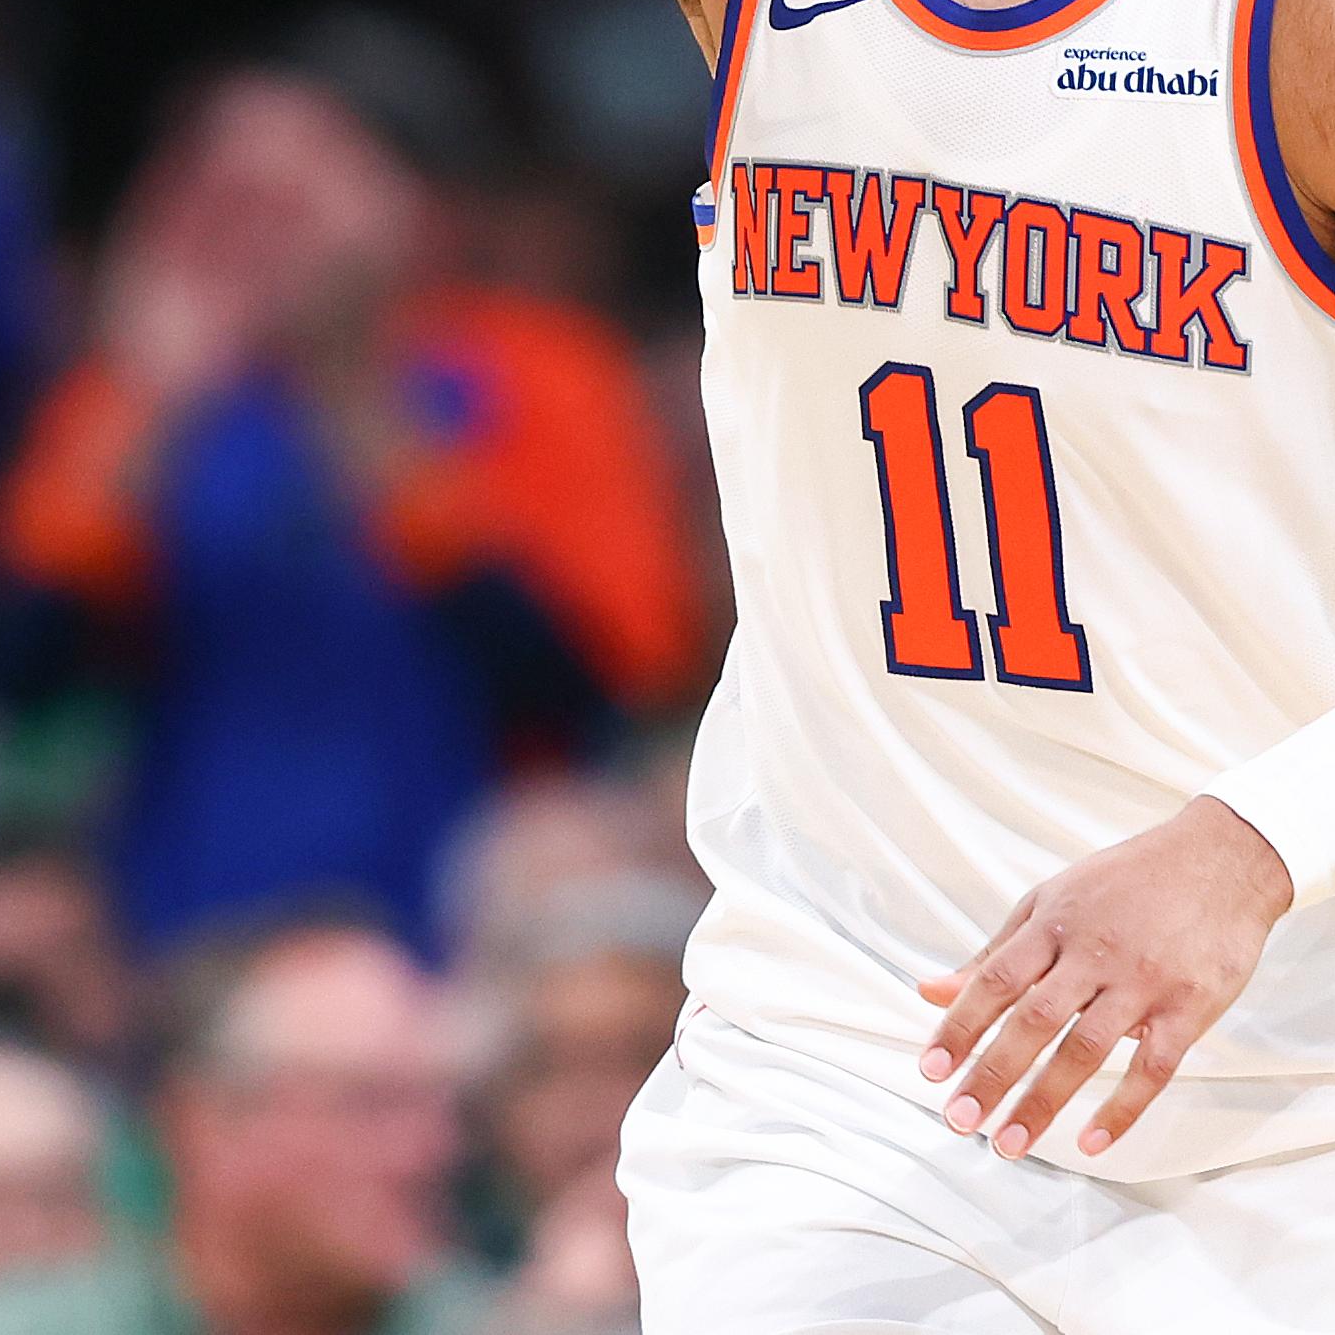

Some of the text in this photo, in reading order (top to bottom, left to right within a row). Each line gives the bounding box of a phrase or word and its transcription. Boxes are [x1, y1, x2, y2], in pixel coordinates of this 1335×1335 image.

[1063, 47, 1147, 62] experience
[1057, 63, 1219, 97] abu dhabi
[859, 360, 1094, 693] 11
